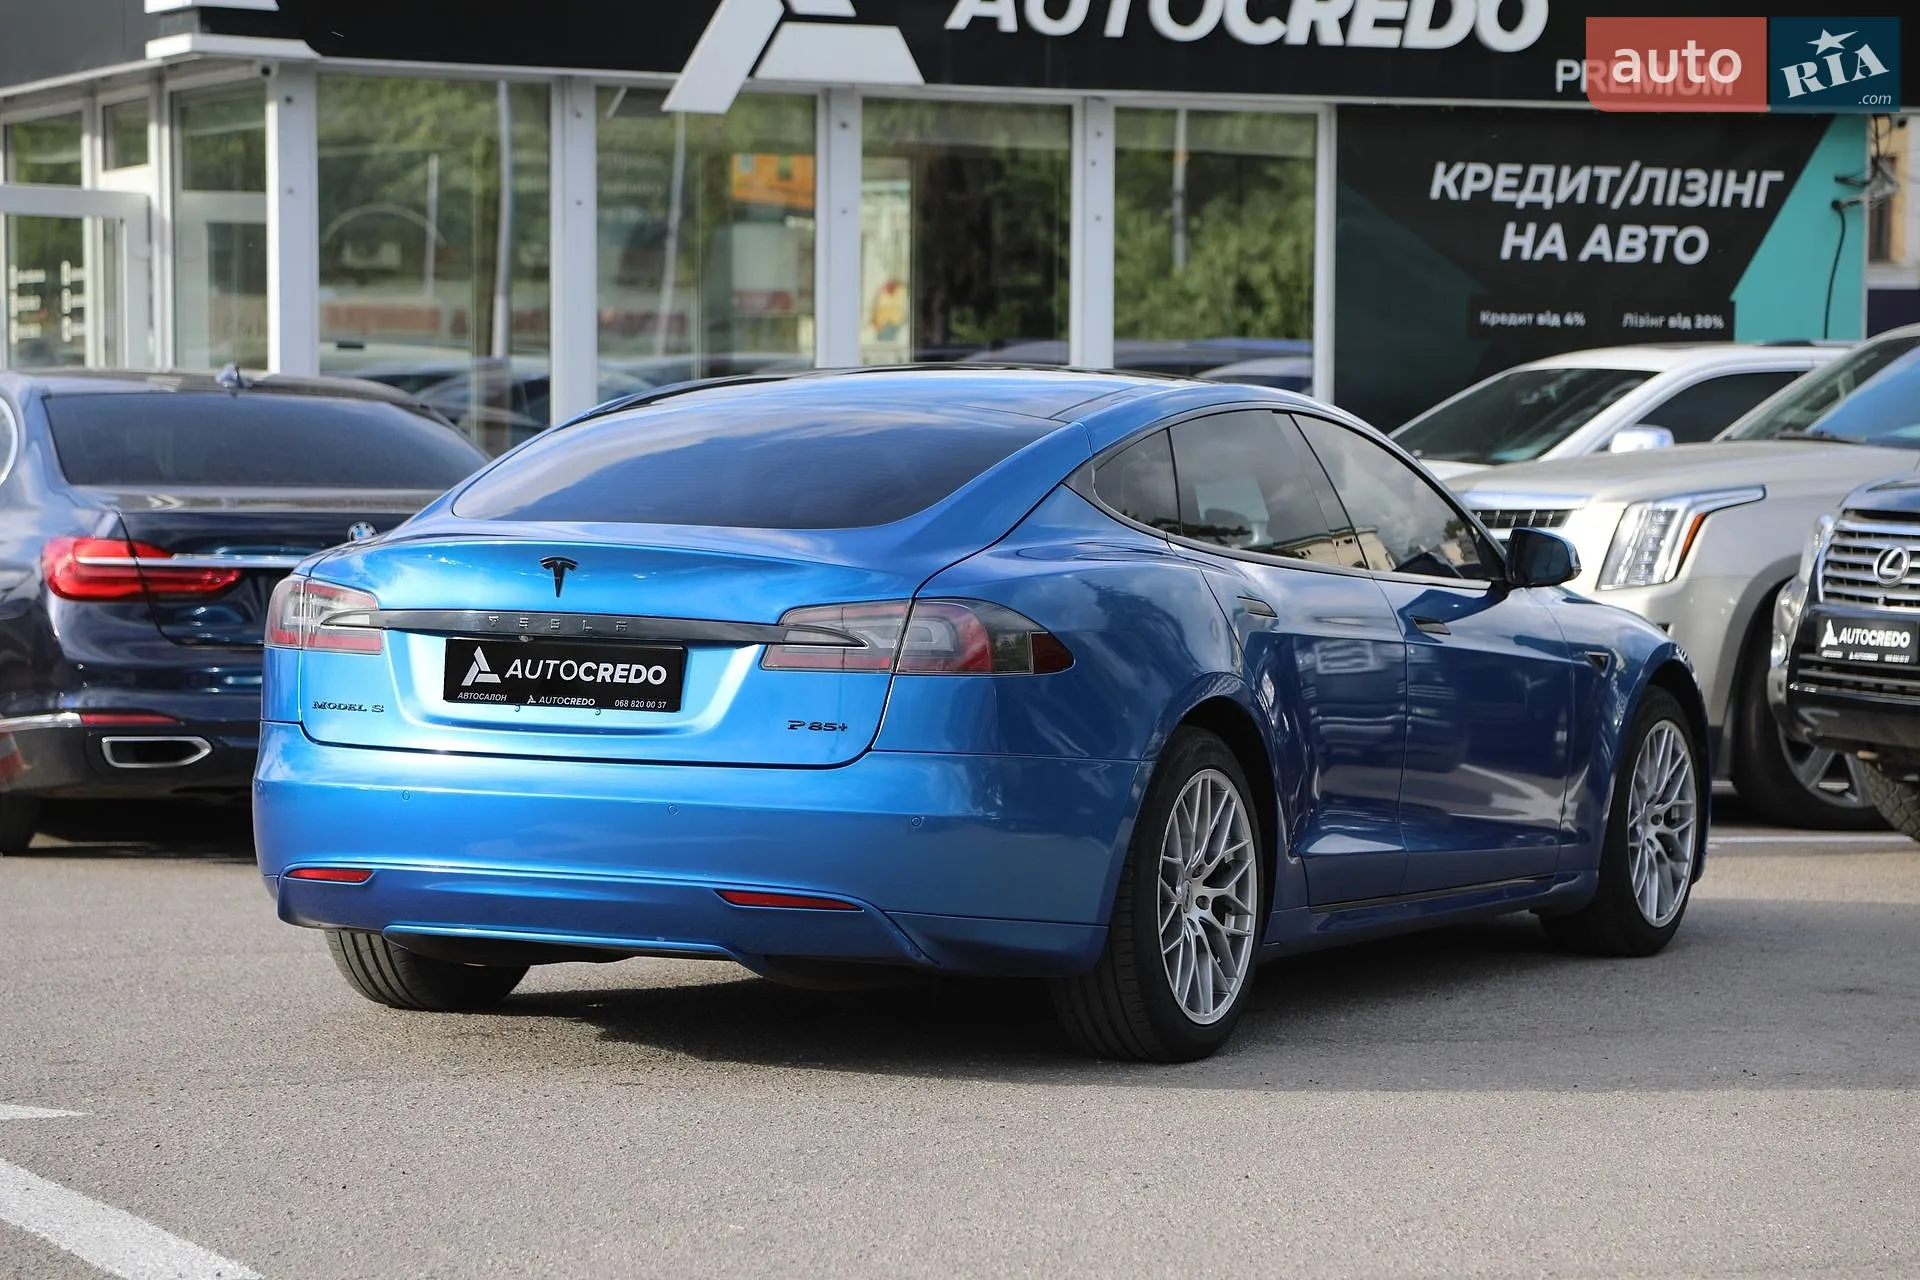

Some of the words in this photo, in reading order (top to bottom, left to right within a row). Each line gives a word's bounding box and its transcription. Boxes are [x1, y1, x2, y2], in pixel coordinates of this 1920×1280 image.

[1430, 160, 1784, 209] КРЕДИТ/ЛІЗІНГ
[1500, 221, 1568, 262] НА
[1578, 223, 1710, 265] АВТО
[1480, 310, 1534, 327] Кредит
[1536, 311, 1561, 327] від
[1563, 311, 1586, 327] 4%
[1622, 312, 1664, 328] Лізінг
[1838, 627, 1911, 648] AUTOCREDO
[504, 658, 667, 685] AUTOCREDO
[457, 691, 507, 702] АВТОСАЛОН
[538, 696, 596, 706] AUTOCREDO
[614, 700, 629, 708] 068
[630, 701, 645, 709] 820
[646, 701, 656, 709] 00
[312, 701, 367, 712] MODEL
[371, 704, 385, 713] S
